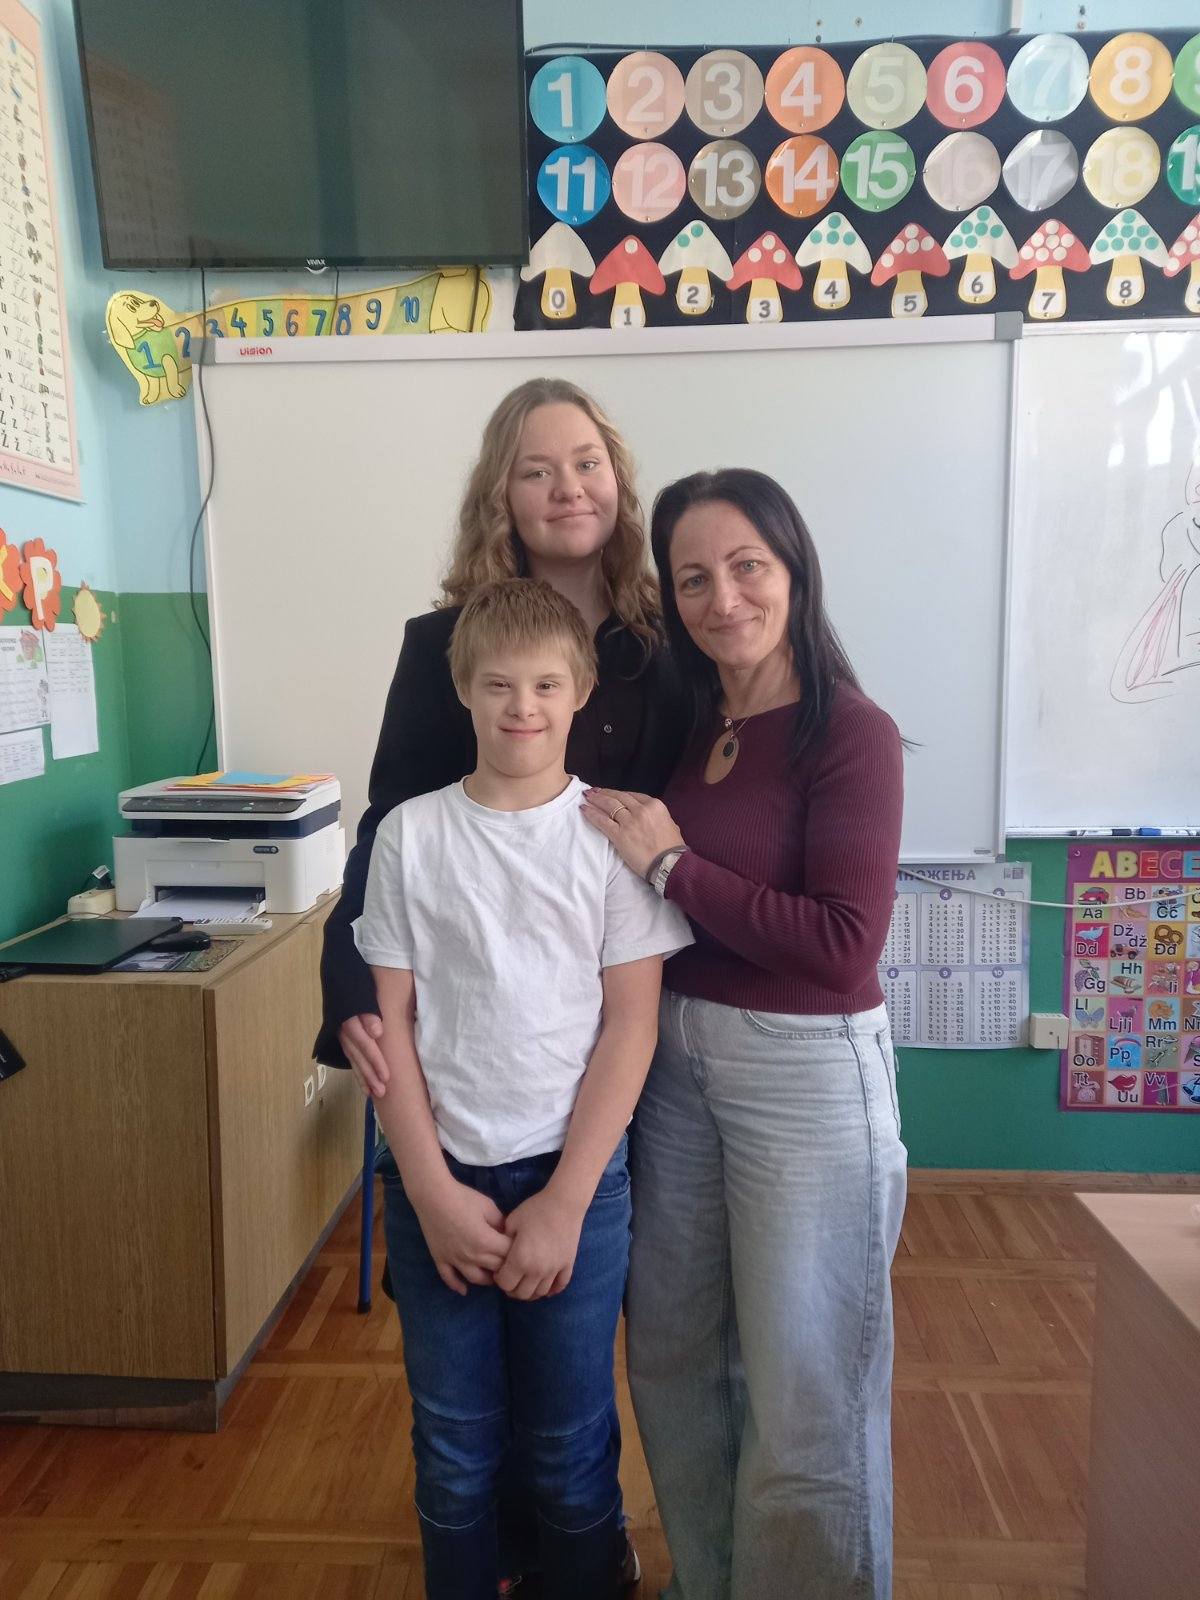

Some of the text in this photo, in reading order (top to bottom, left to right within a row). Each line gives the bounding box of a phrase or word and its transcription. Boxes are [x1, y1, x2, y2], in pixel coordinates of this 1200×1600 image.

[548, 72, 574, 127] 1
[627, 65, 666, 122] 2
[703, 62, 743, 121] 3
[780, 62, 822, 117] 4
[864, 57, 905, 114] 5
[944, 56, 985, 113] 6
[1026, 46, 1073, 107] 7
[1110, 47, 1152, 105] 8
[545, 156, 596, 212] 11
[620, 153, 679, 208] 12
[694, 150, 755, 207] 13
[774, 145, 835, 204] 14
[845, 142, 908, 200] 15
[934, 144, 987, 198] 16
[1009, 143, 1072, 204] 17
[1089, 140, 1151, 197] 18
[551, 275, 1131, 325] 0 1 2 3 4 5 6 7 8
[137, 341, 162, 369] 1
[175, 326, 191, 358] 2
[230, 307, 247, 338] 4
[262, 309, 274, 337] 5
[285, 309, 299, 336] 6
[311, 309, 327, 336] 7
[336, 303, 351, 336] 8
[366, 298, 382, 330] 9
[400, 295, 420, 323] 10
[239, 346, 273, 357] vision
[1125, 887, 1146, 900] Bb
[1082, 907, 1103, 919] Aa
[1114, 924, 1133, 937] Dž
[1129, 934, 1148, 948] dž
[1076, 942, 1098, 955] Dd
[1121, 963, 1142, 974] Hh
[1083, 978, 1106, 993] Gg
[1148, 1019, 1177, 1030] Mm
[1146, 1036, 1163, 1048] Rr
[1073, 1054, 1096, 1067] Oo
[1110, 1048, 1130, 1062] Pp
[1074, 1073, 1088, 1085] Tt
[1146, 1073, 1165, 1085] Vv
[1117, 1091, 1139, 1103] Uu
